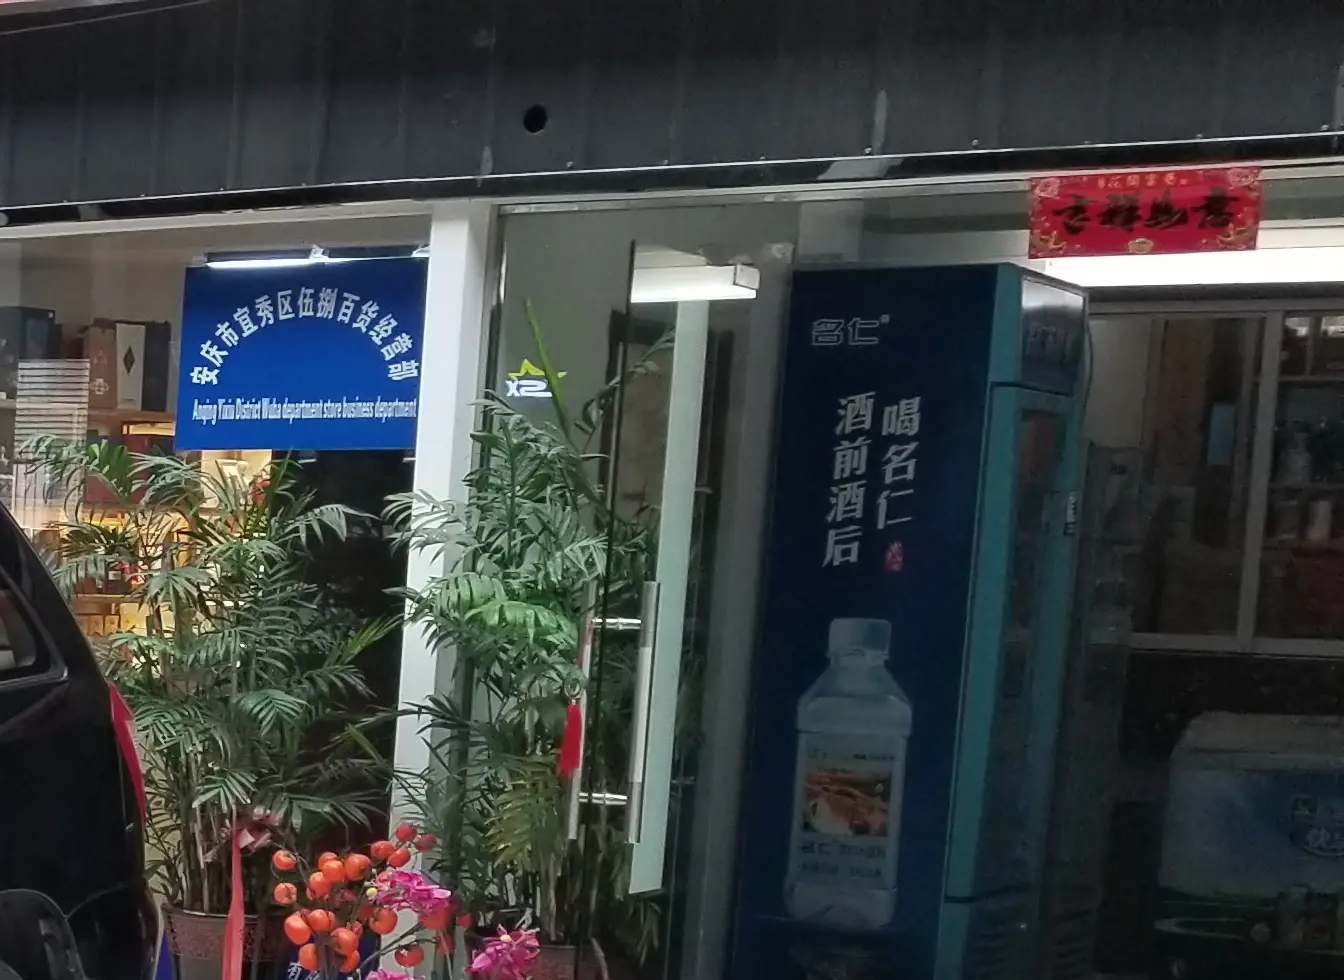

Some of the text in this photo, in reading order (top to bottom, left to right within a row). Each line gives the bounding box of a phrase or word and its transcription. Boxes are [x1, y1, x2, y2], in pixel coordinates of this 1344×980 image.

[190, 287, 419, 386] 安庆市宜秀区伍捌百货经营部
[812, 318, 879, 345] 名仁
[235, 397, 260, 419] District
[282, 397, 323, 424] department
[324, 399, 342, 418] store
[343, 396, 374, 418] business
[375, 396, 416, 423] department
[822, 391, 876, 568] 酒前酒后
[876, 396, 921, 529] 喝名仁
